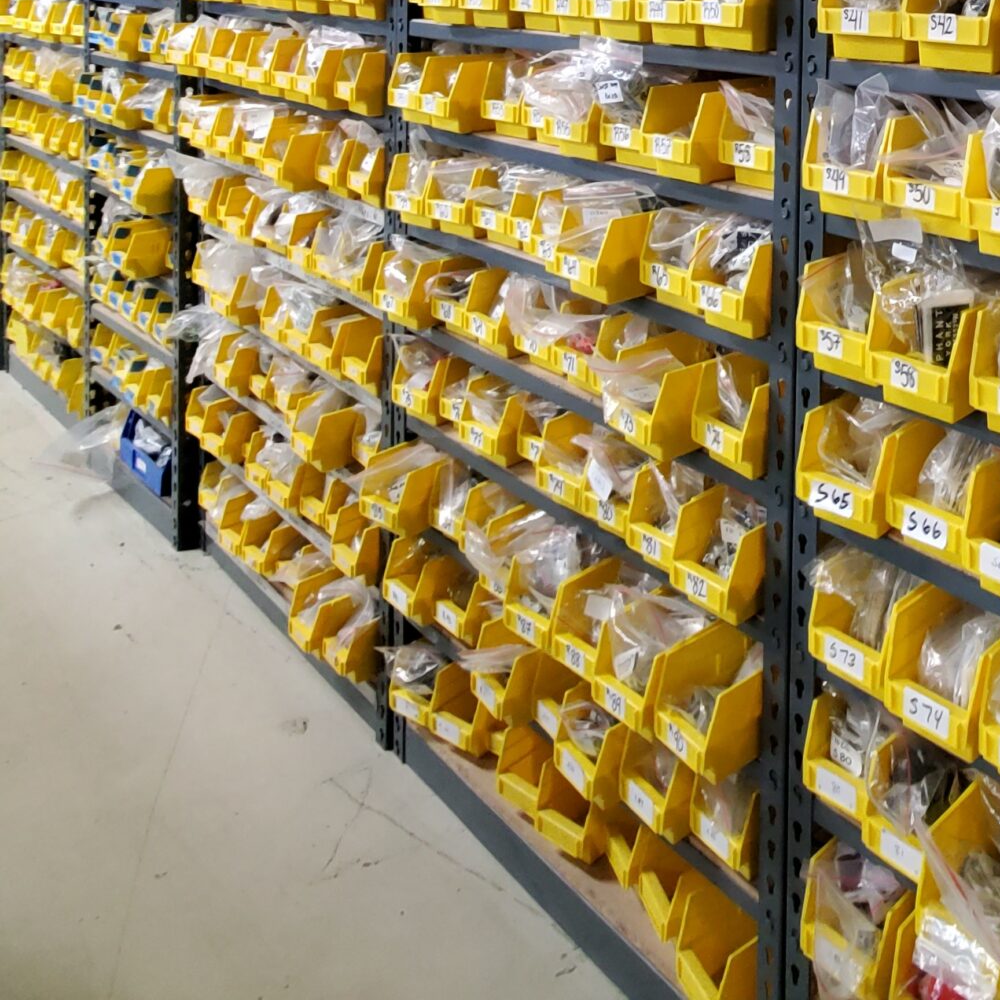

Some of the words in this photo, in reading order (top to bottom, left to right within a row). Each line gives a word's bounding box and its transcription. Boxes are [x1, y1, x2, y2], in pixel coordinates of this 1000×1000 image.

[703, 2, 719, 19] R50
[844, 10, 862, 30] S41
[931, 15, 953, 34] S42
[614, 126, 629, 143] R56
[909, 184, 930, 205] S50
[652, 265, 667, 286] R65
[702, 287, 719, 308] R66
[821, 330, 840, 351] S57
[564, 353, 575, 371] R71
[549, 474, 564, 495] R79
[815, 484, 850, 509] S65
[909, 512, 942, 540] S66
[643, 535, 656, 555] R81
[687, 574, 706, 597] R82
[566, 646, 580, 668] R88
[830, 642, 856, 667] S73
[606, 688, 621, 713] R89
[910, 697, 943, 728] S74
[669, 724, 684, 752] R90
